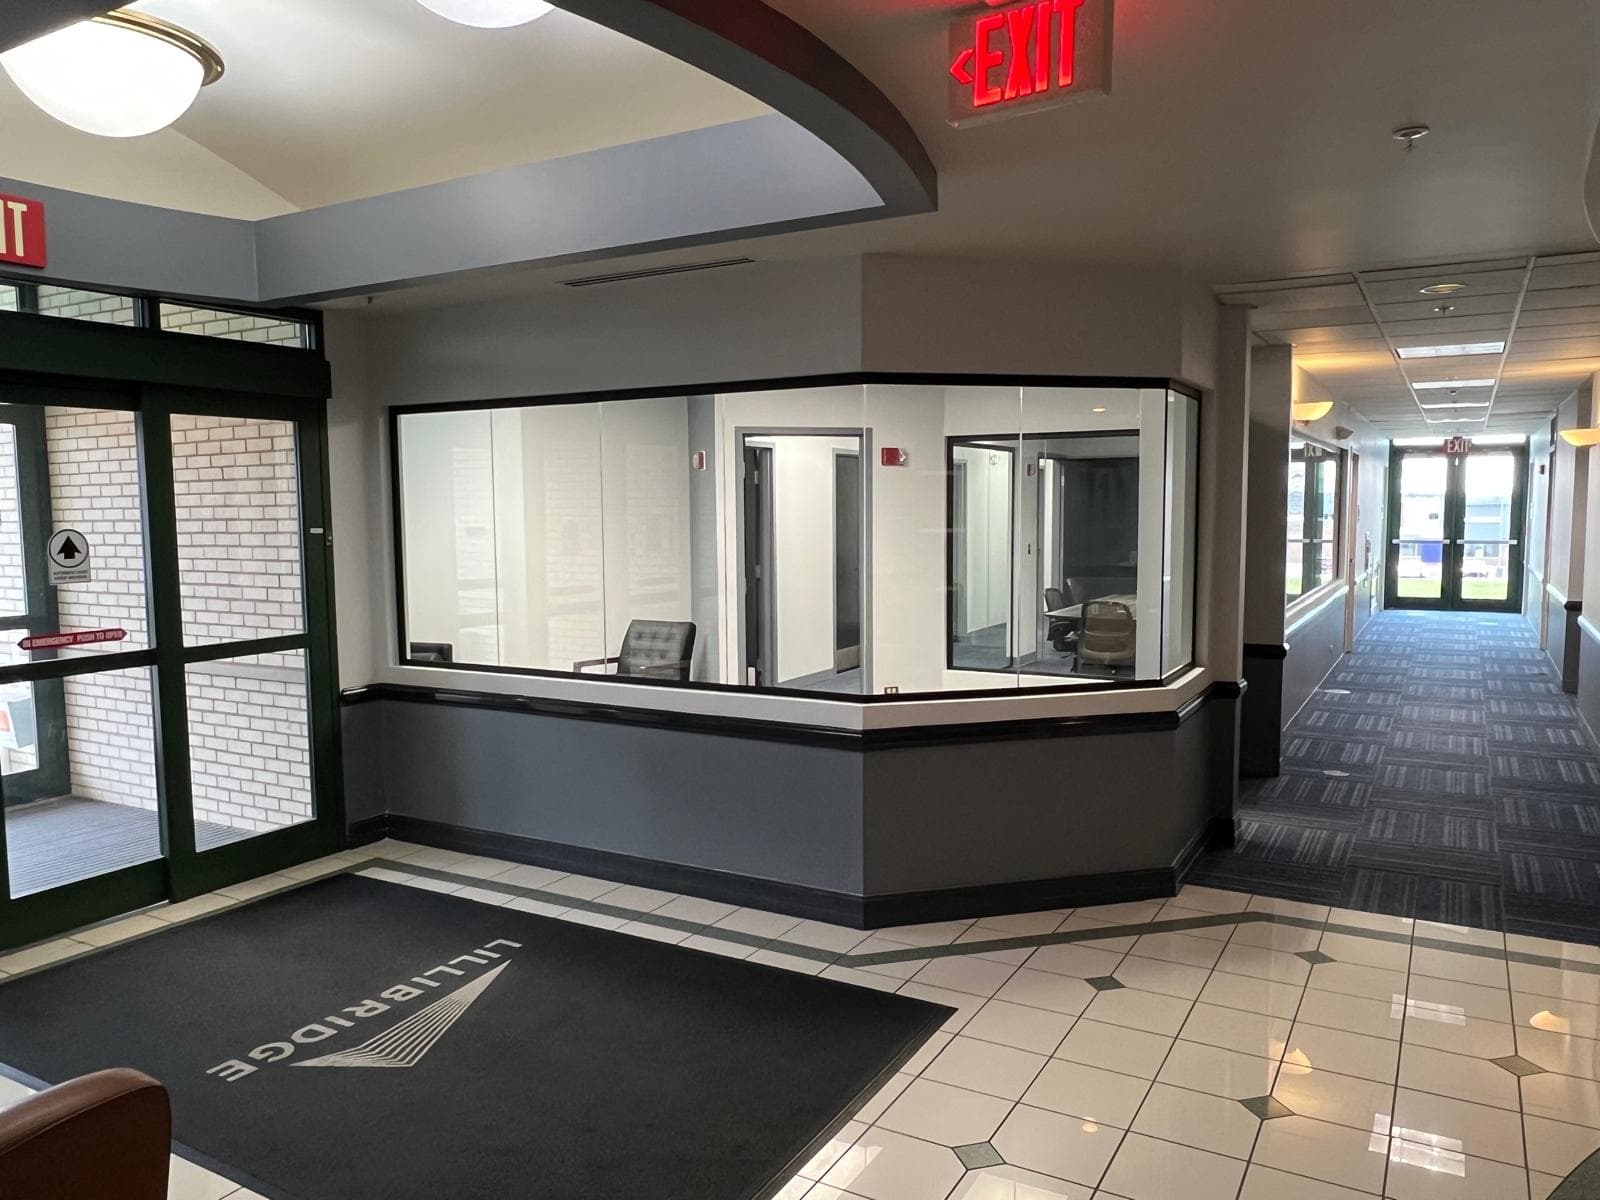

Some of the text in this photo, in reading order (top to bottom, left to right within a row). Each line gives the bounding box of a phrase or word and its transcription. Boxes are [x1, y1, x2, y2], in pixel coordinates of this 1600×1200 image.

[974, 0, 1085, 107] EXIT
[1447, 439, 1470, 453] EXIT
[95, 632, 105, 641] TO
[205, 938, 523, 1083] LILLIBRIDGE
